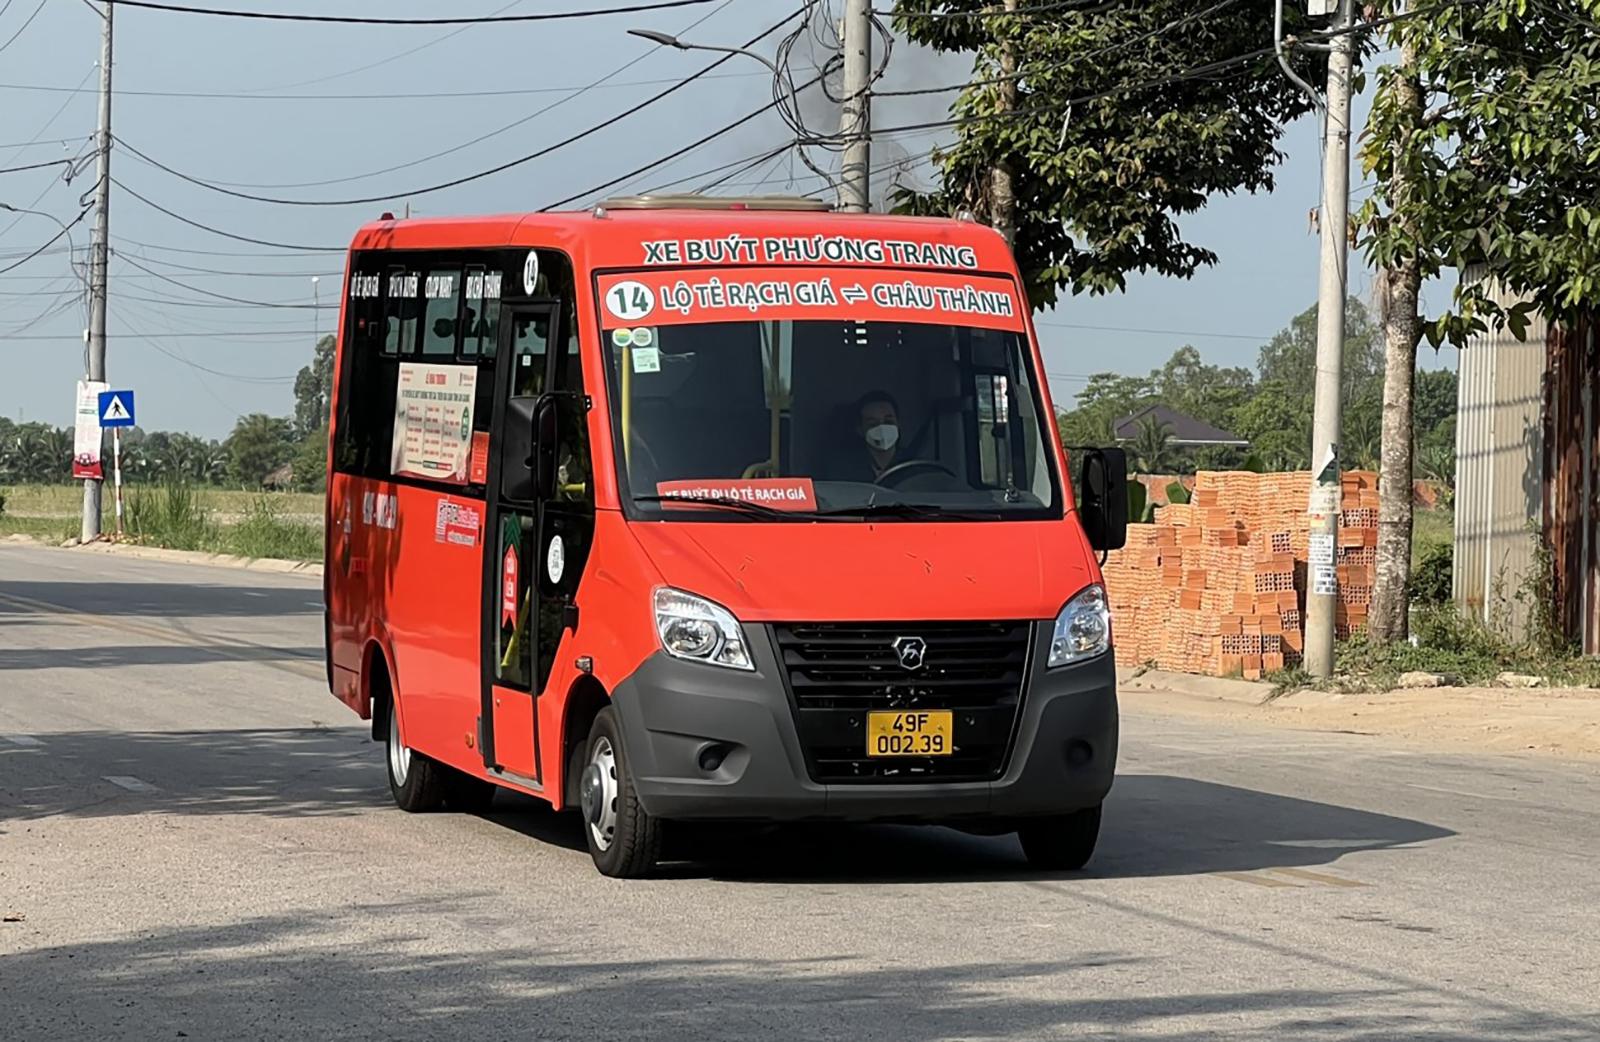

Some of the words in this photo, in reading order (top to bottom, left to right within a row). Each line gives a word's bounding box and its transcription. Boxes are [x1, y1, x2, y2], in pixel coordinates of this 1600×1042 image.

[645, 241, 679, 263] XE
[686, 235, 757, 262] BUÝT
[765, 235, 883, 262] PHƯƠNG
[887, 242, 976, 267] TRANG
[613, 286, 649, 314] 14
[661, 282, 692, 314] LỘ
[695, 278, 724, 307] TẺ
[728, 283, 791, 311] RẠCH
[796, 280, 835, 305] GIÁ
[873, 282, 934, 307] CHÂU
[936, 286, 1012, 315] THÀNH
[786, 486, 807, 500] GIÁ
[892, 714, 929, 733] 49F
[877, 735, 944, 754] 002.39
